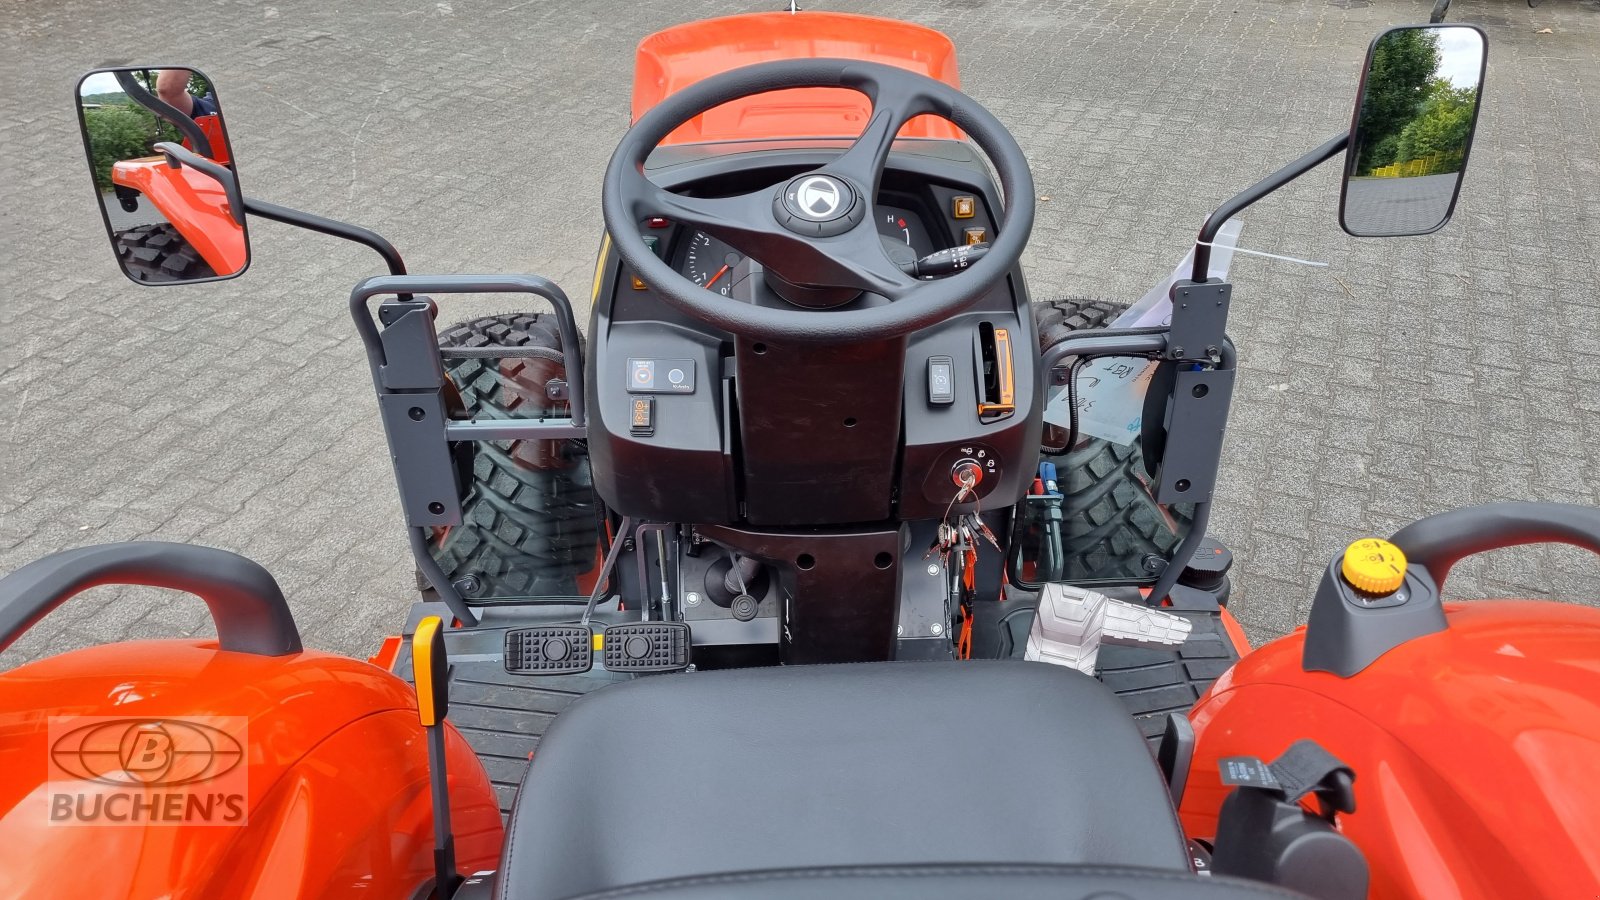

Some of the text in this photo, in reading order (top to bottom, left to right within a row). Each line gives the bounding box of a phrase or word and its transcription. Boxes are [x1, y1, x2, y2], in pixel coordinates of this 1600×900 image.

[887, 215, 894, 223] H
[704, 238, 710, 246] 2
[702, 272, 707, 280] 1
[721, 287, 727, 295] 0
